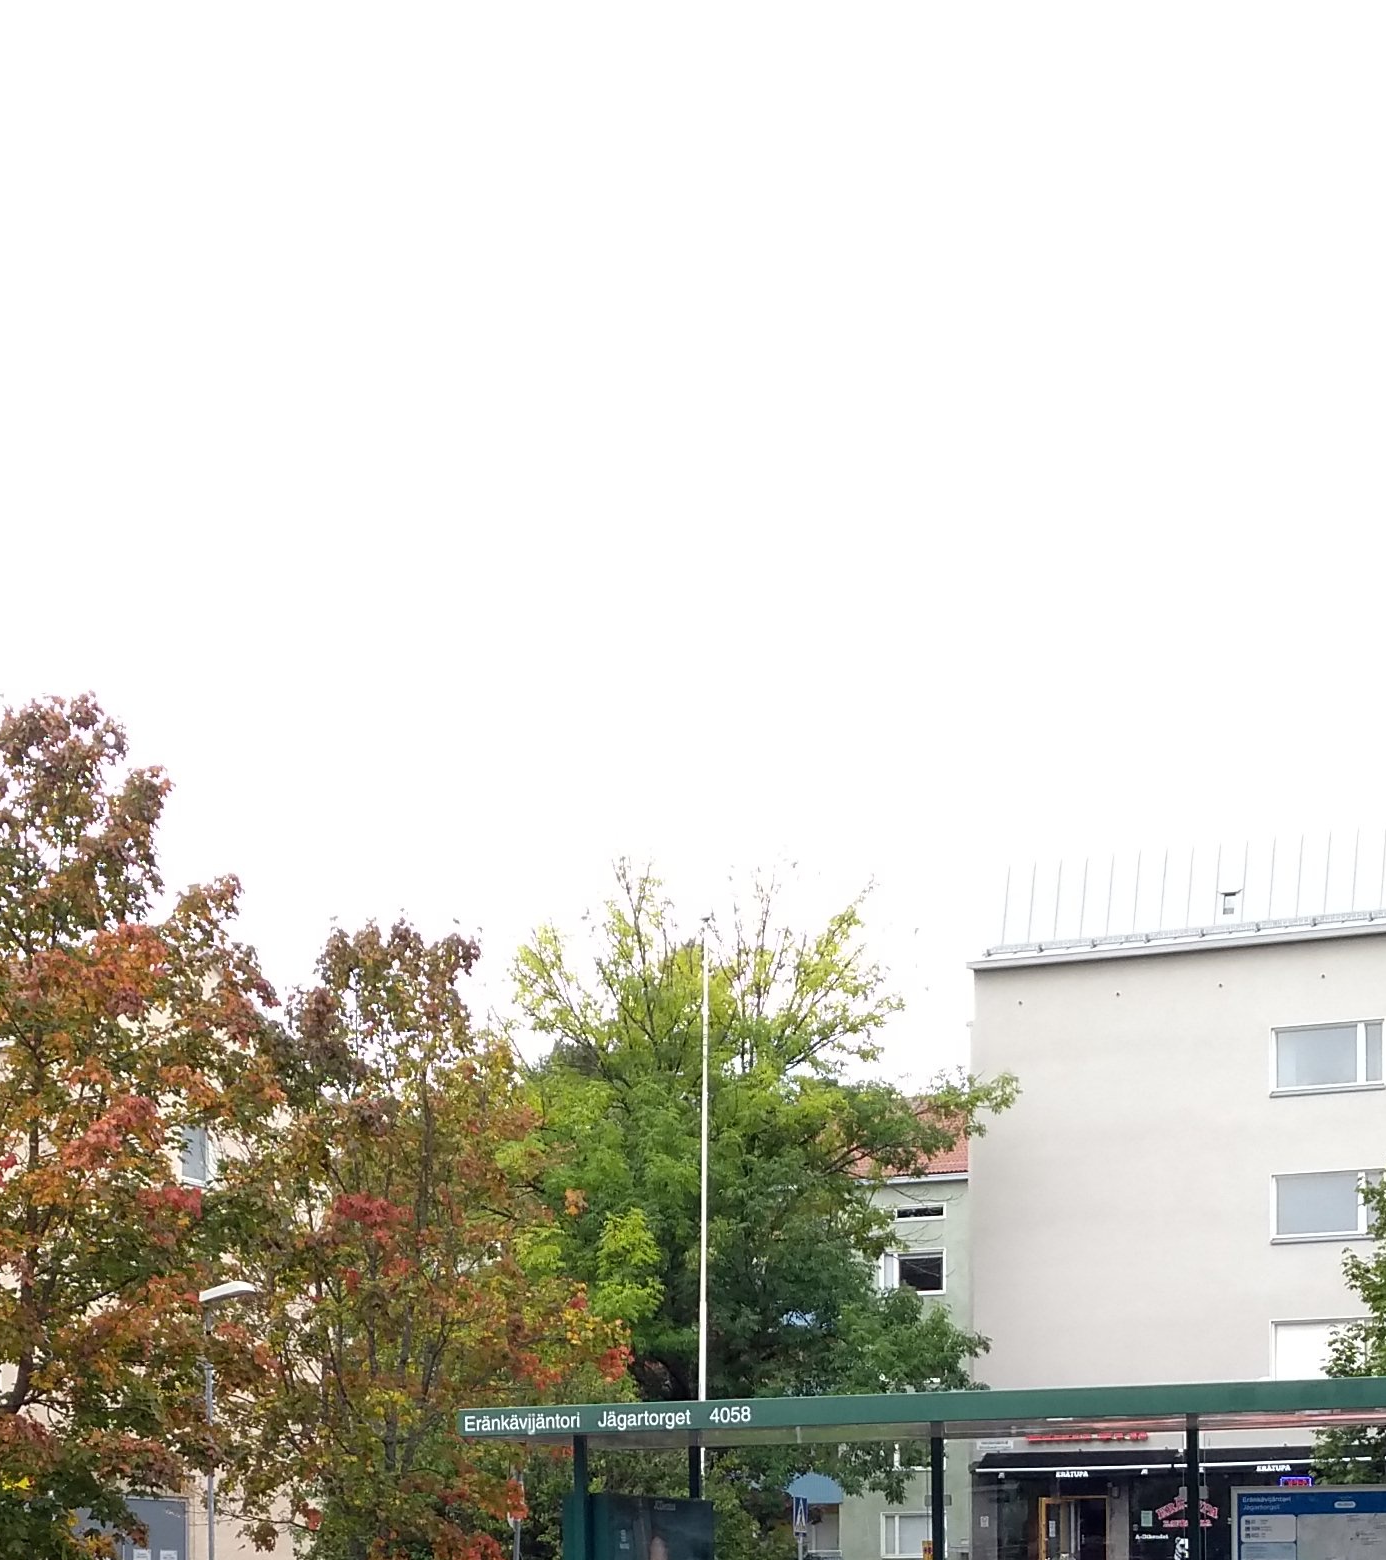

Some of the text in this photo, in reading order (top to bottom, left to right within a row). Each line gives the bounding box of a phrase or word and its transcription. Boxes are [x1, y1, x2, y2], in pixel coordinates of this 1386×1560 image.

[463, 1406, 751, 1434] Eränkävijäntori Jägartorget 4058
